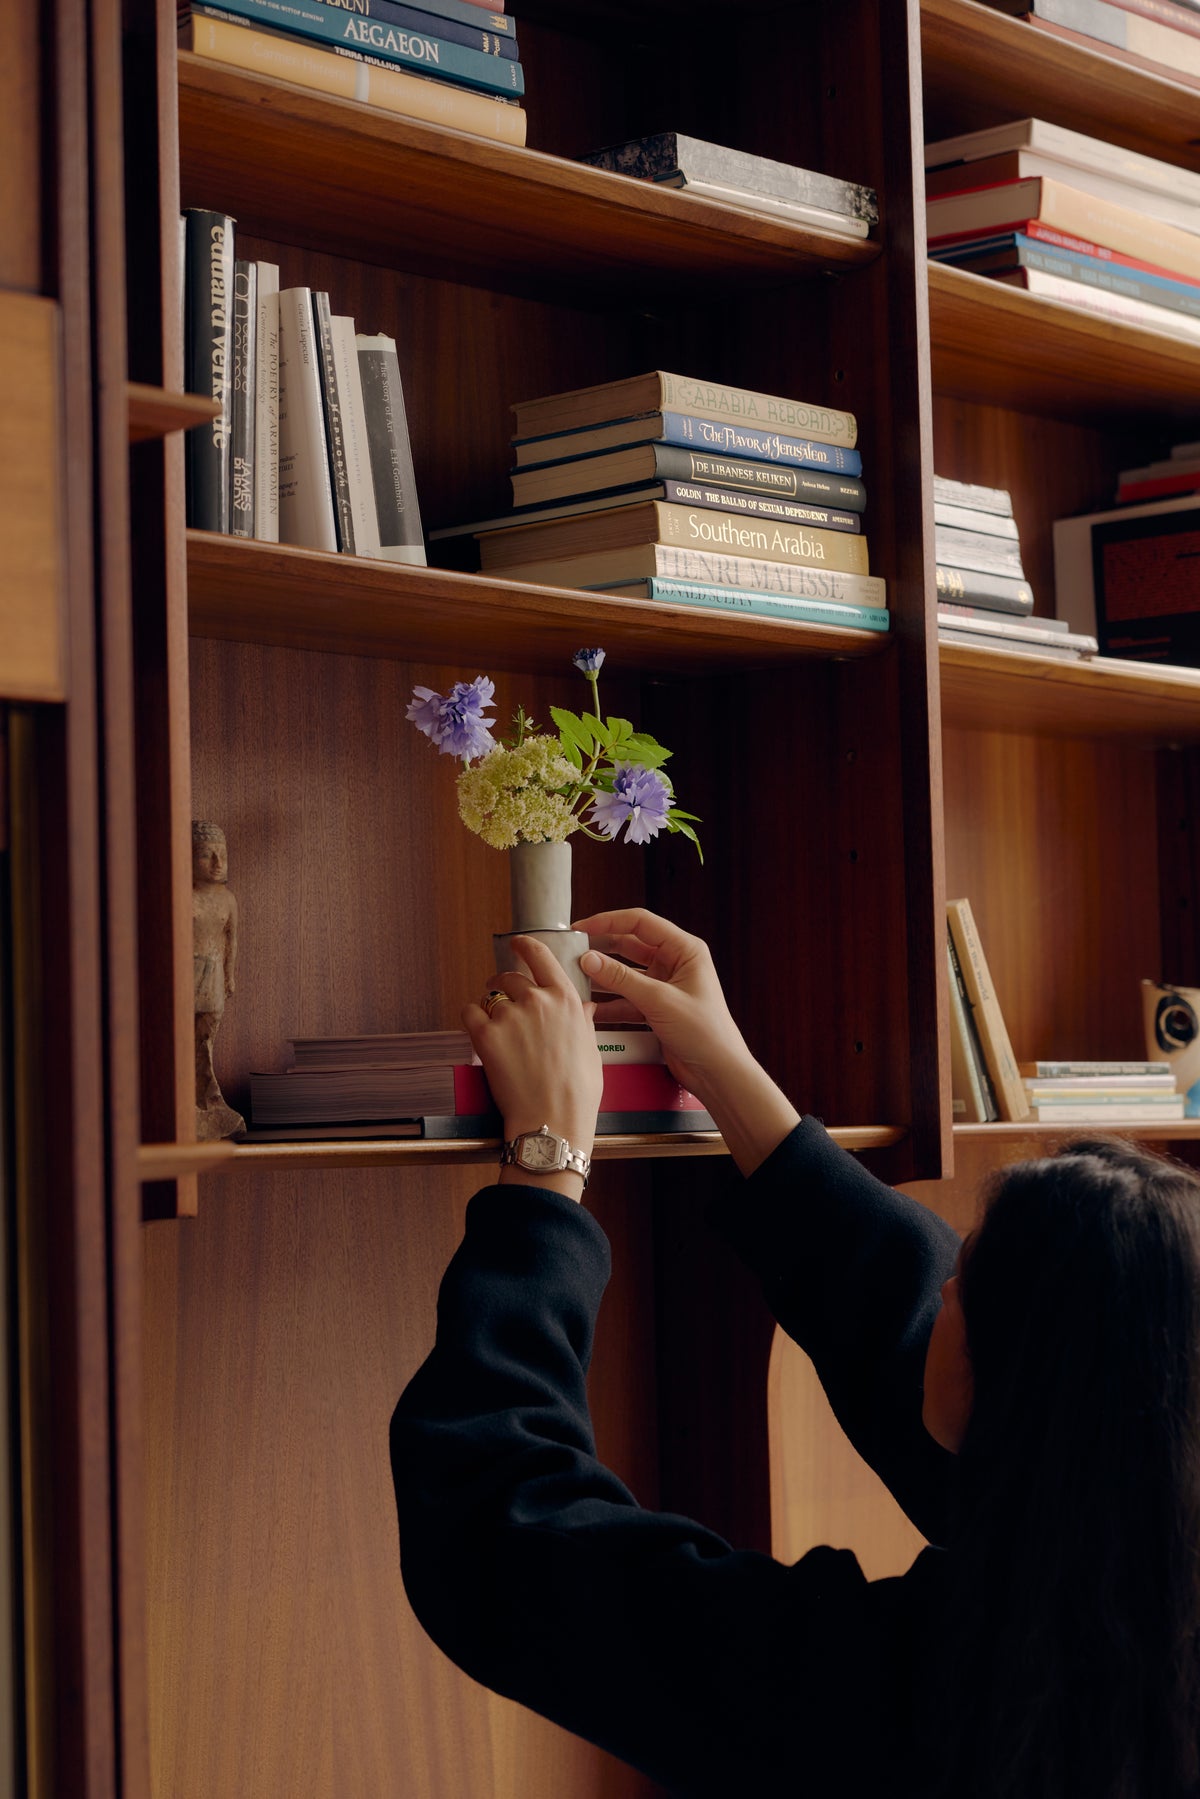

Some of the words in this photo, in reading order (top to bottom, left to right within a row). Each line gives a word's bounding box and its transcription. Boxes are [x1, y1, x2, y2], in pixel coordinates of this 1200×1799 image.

[334, 45, 363, 61] TERRA
[364, 54, 401, 72] NULLIUS
[343, 17, 439, 64] AEGAEON
[269, 331, 278, 349] The
[269, 353, 278, 403] POETRY
[380, 361, 388, 378] The
[211, 334, 231, 449] verkde
[323, 320, 336, 395] BARBARA
[330, 403, 347, 487] HEPWORTH
[382, 382, 391, 402] Story
[384, 407, 393, 417] of
[694, 386, 759, 417] ARABIA
[767, 403, 831, 432] REBORN
[269, 419, 278, 456] ARAB
[386, 420, 394, 433] Art
[699, 423, 724, 443] The
[724, 426, 760, 453] Flavor
[761, 436, 773, 458] of
[772, 434, 830, 464] Jerusalem
[240, 458, 252, 511] JAMES
[269, 462, 278, 515] WOMEN
[392, 468, 406, 513] Gombrich
[696, 461, 709, 473] DE
[711, 463, 754, 481] LIBANESE
[755, 471, 792, 487] KEUKEN
[676, 487, 701, 501] GOLDIN
[705, 492, 720, 504] THE
[721, 495, 747, 509] BALLAD
[748, 501, 758, 511] OF
[758, 502, 785, 516] SEXUAL
[785, 506, 828, 523] DEPENDENCY
[688, 513, 768, 550] Southern
[771, 528, 825, 560] Arabia
[660, 548, 741, 587] HENRI
[750, 562, 844, 600] MATISSE
[597, 1044, 626, 1052] MOREU
